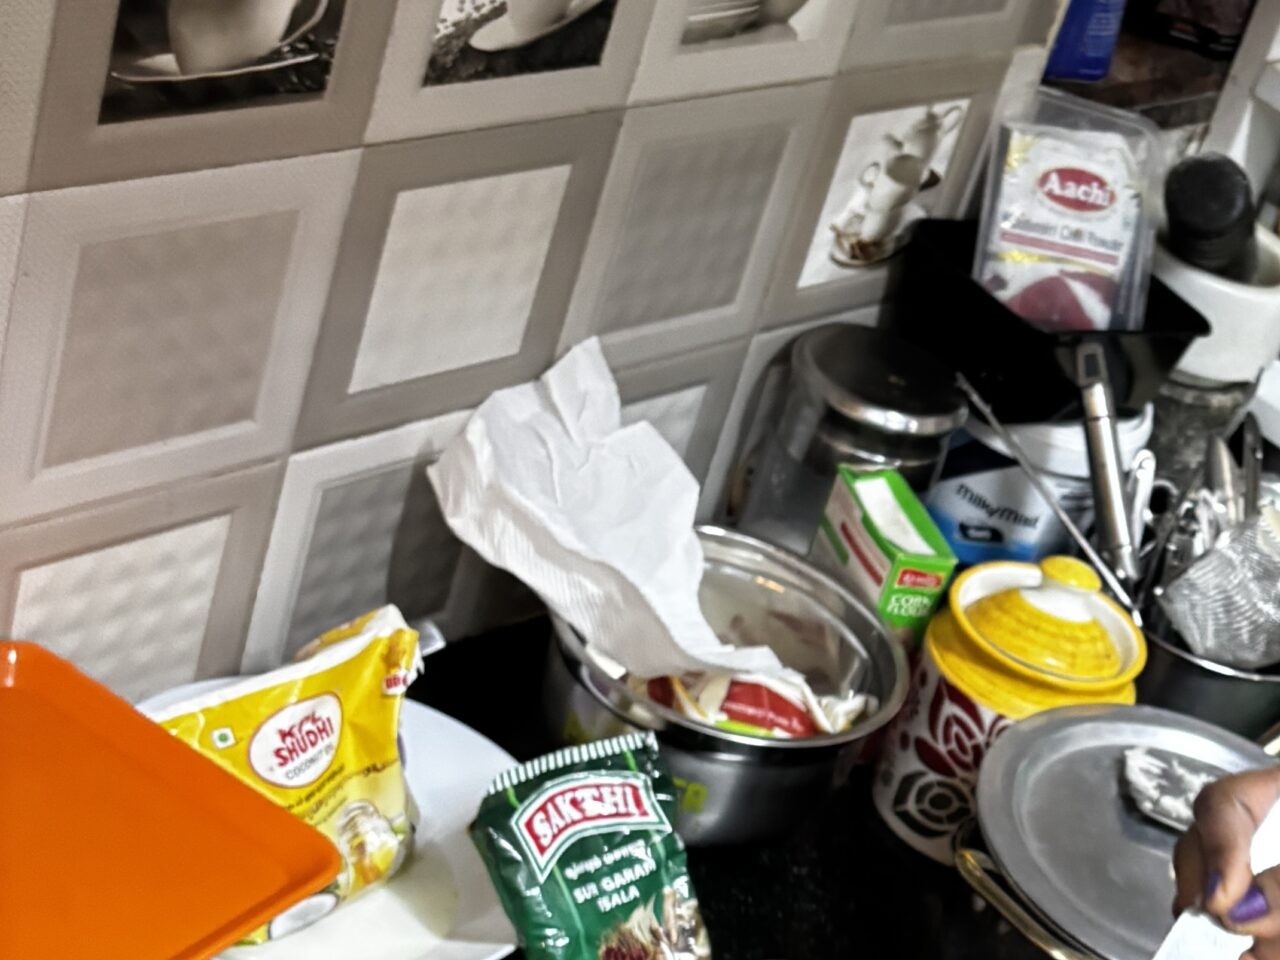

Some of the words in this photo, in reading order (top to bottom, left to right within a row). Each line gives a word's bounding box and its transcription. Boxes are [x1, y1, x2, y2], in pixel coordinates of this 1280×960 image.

[1043, 171, 1110, 206] Aachi
[273, 717, 335, 768] SHUDHI
[531, 785, 641, 849] SAKTHI
